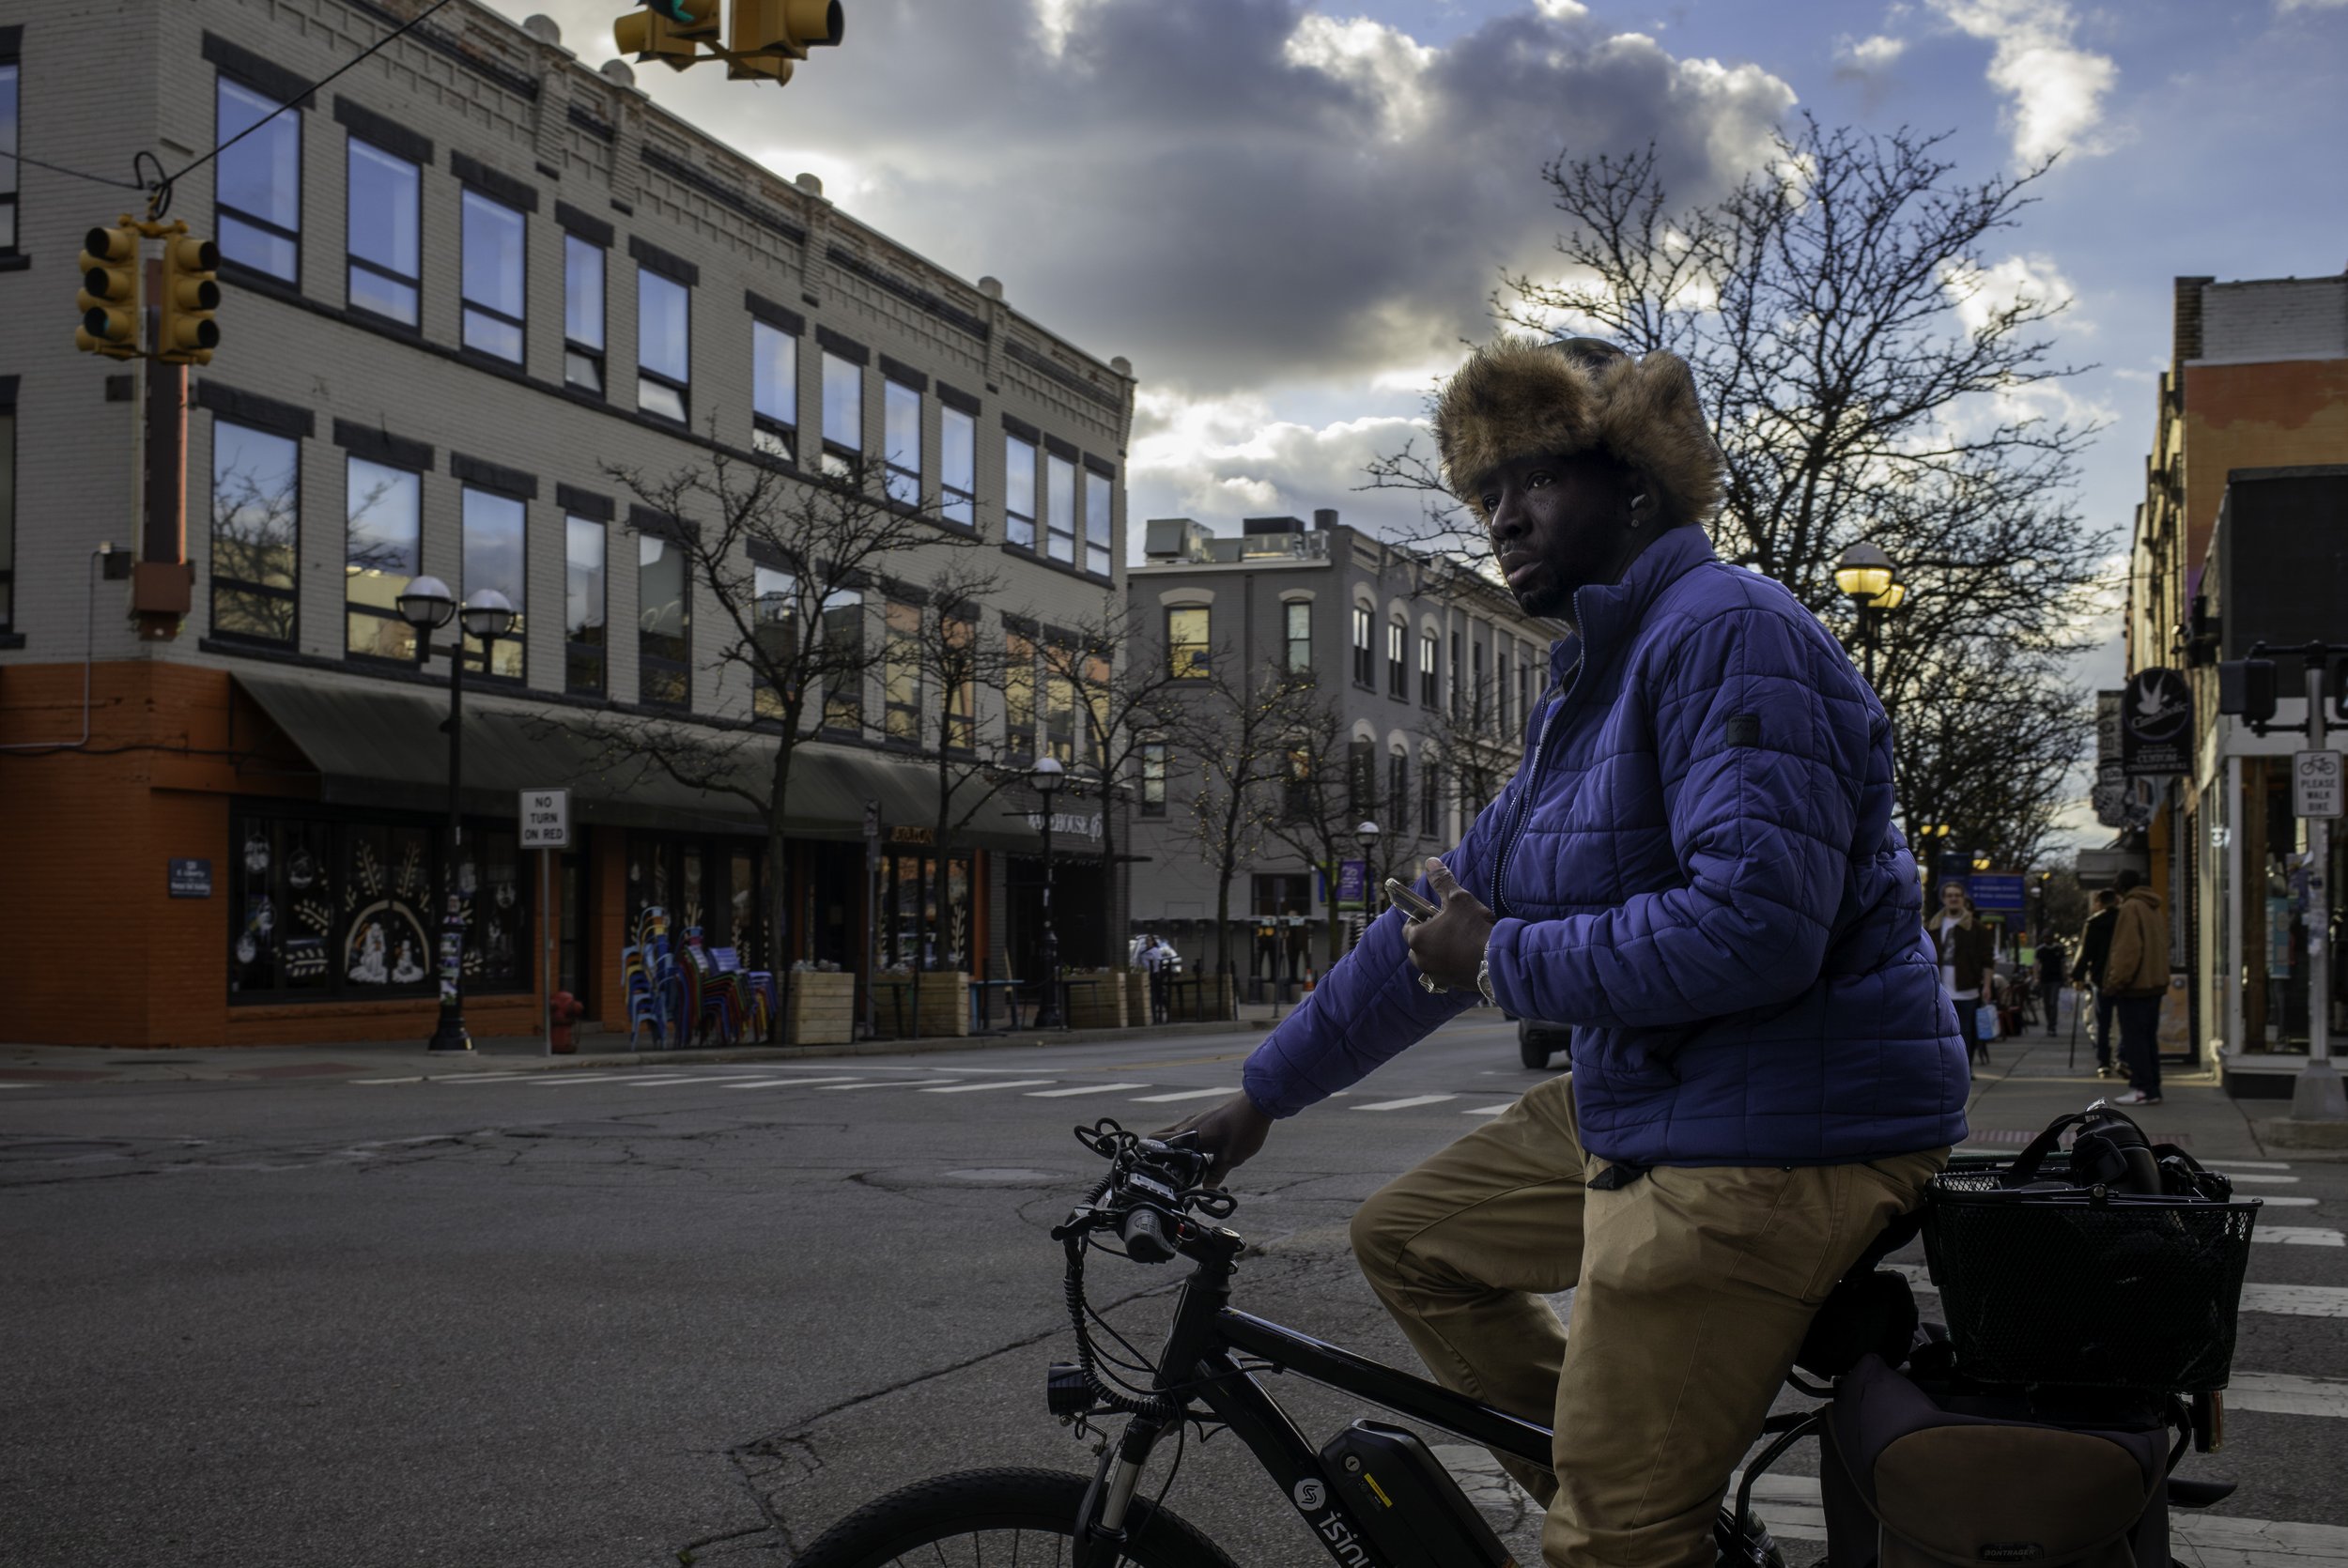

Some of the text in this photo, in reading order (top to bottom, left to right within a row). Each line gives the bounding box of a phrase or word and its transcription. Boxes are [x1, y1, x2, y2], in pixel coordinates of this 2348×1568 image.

[2300, 778, 2336, 788] PLEASE
[2307, 792, 2330, 800] WALK
[534, 796, 552, 807] NO
[2308, 802, 2329, 811] BIKE
[530, 812, 558, 823] TURN
[525, 828, 564, 839] ON RED
